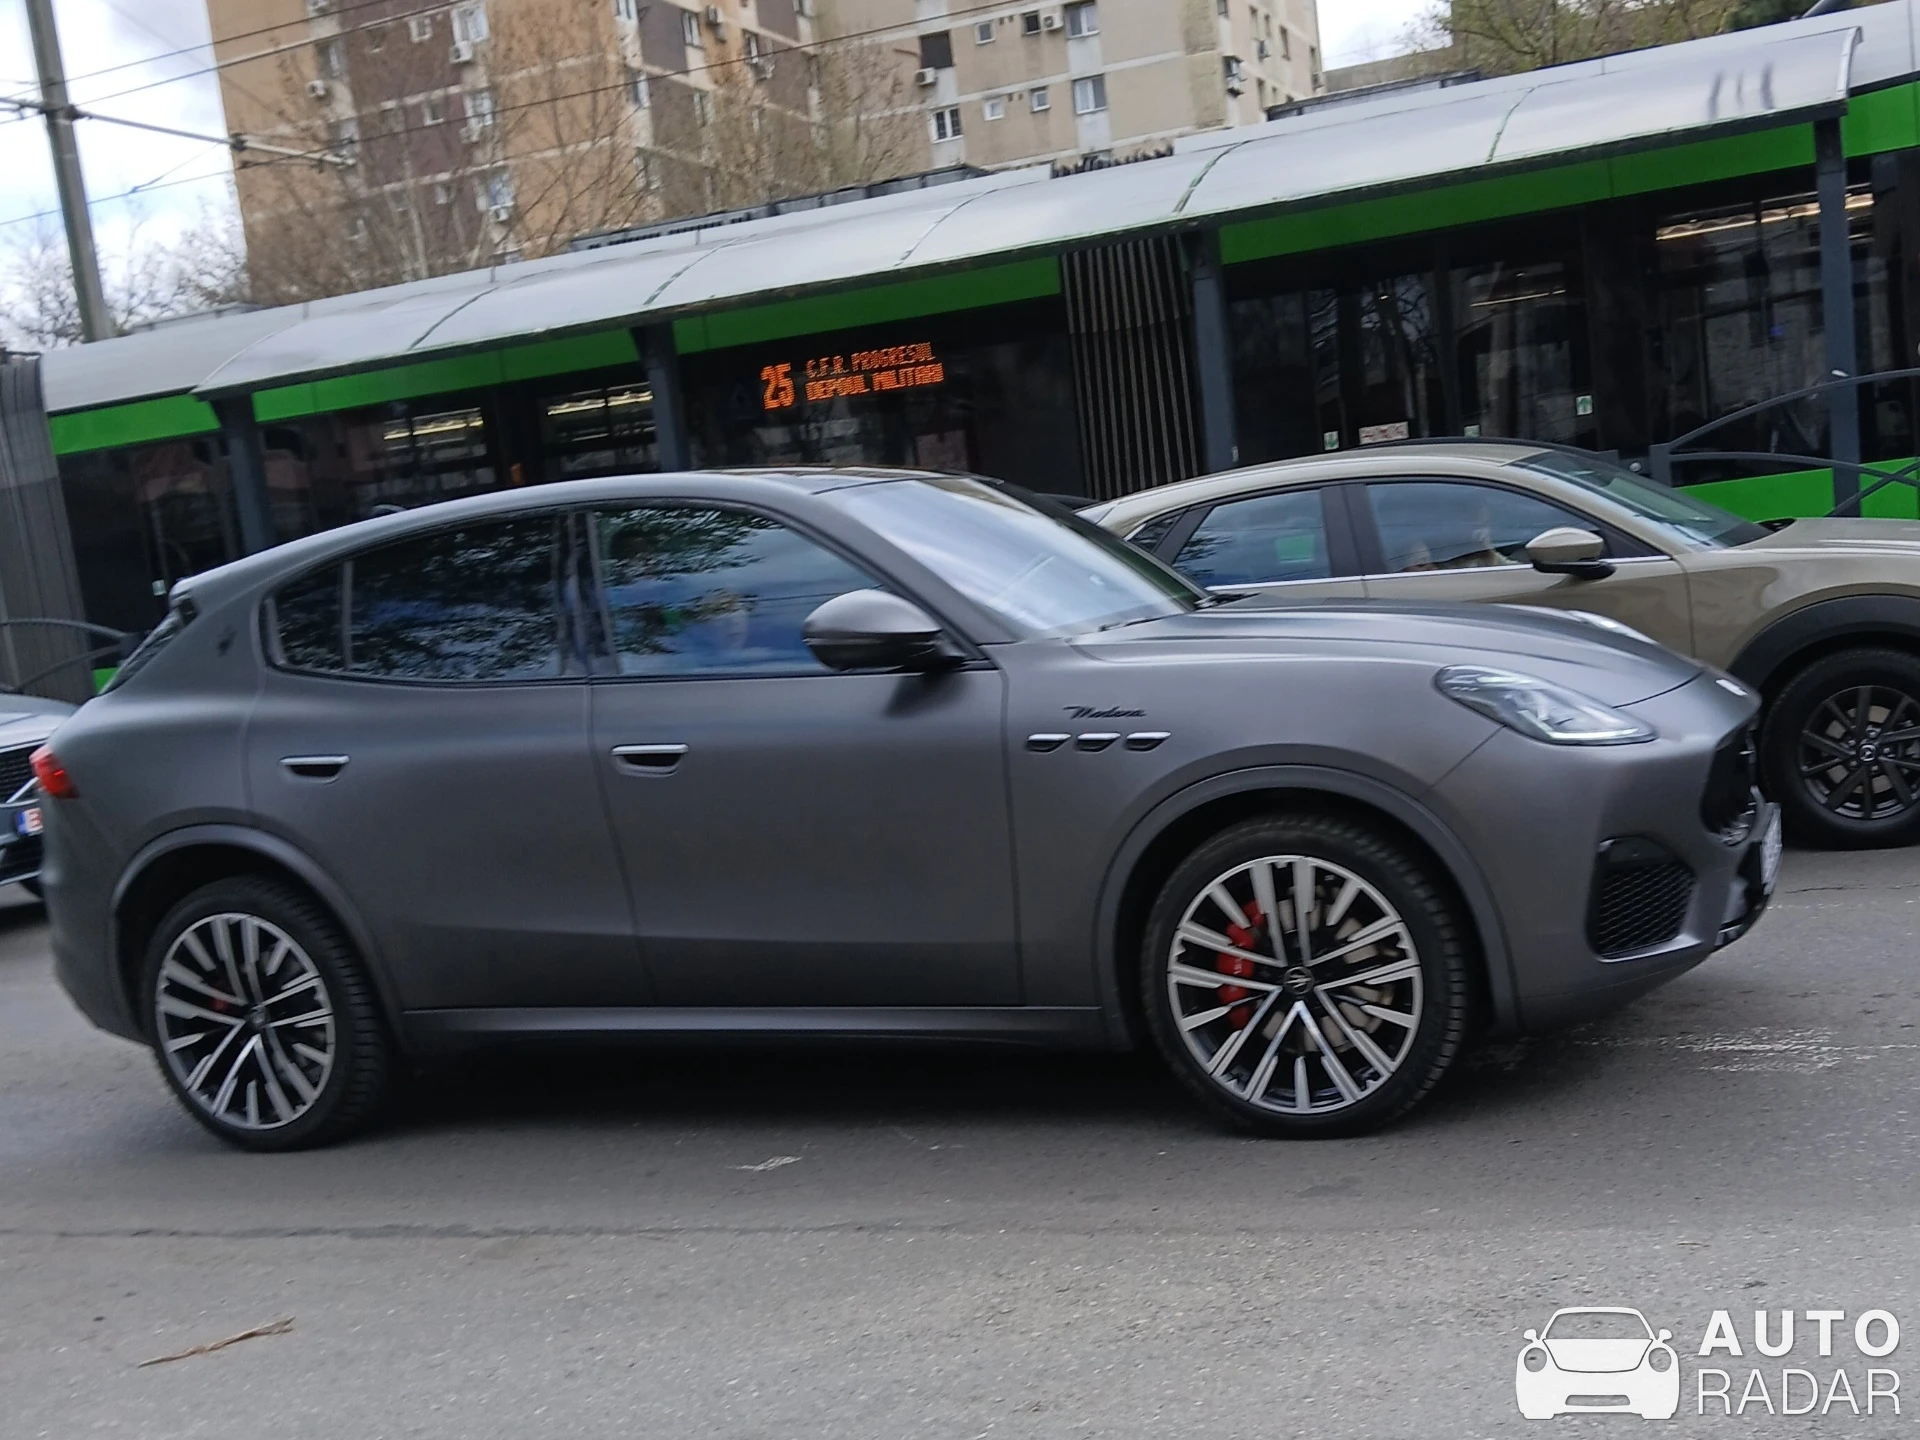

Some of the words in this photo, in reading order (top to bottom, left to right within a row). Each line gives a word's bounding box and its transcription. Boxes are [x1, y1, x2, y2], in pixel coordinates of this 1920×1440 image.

[760, 363, 796, 409] 25
[805, 374, 870, 401] DEPOUL
[872, 363, 944, 391] MILITARI
[1063, 705, 1148, 720] Modena
